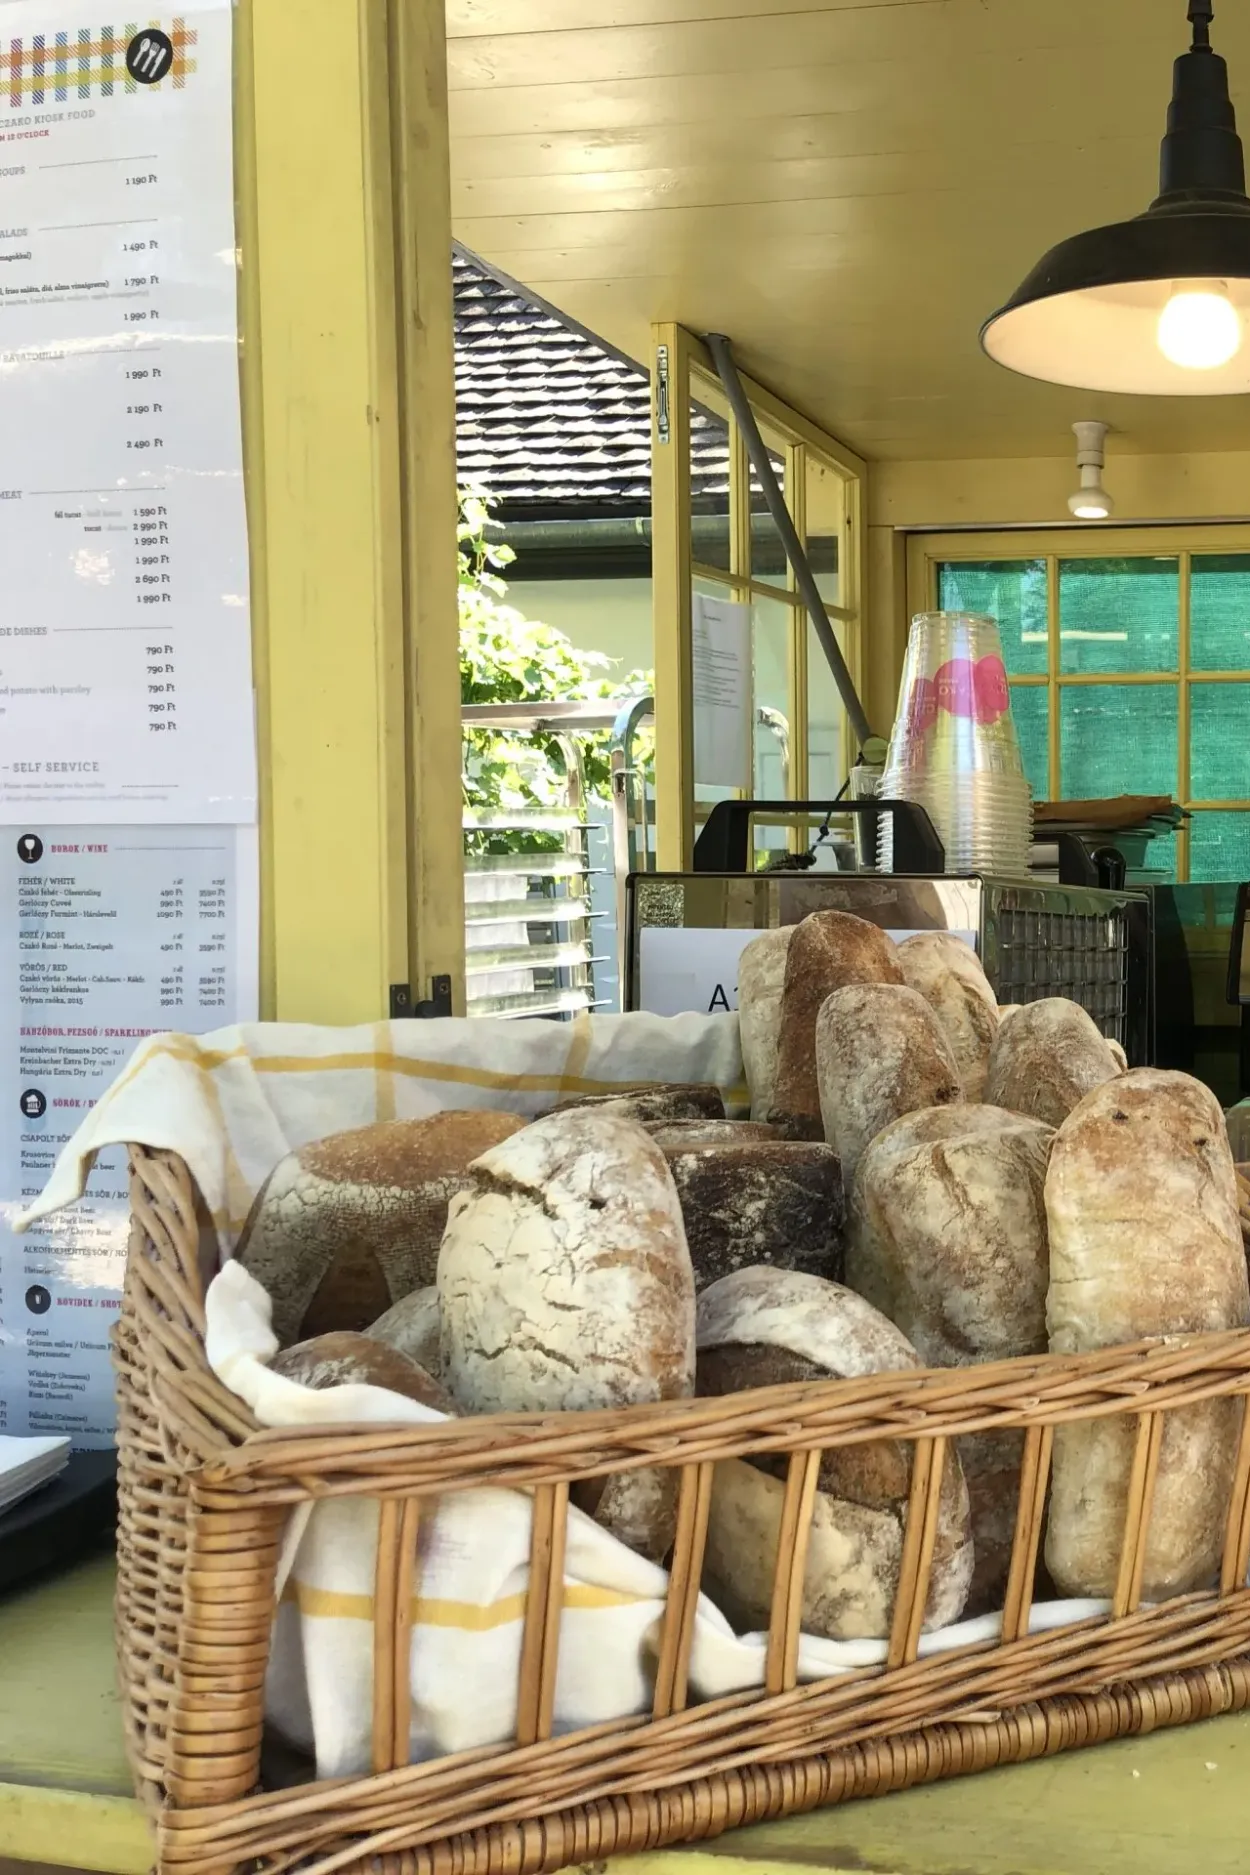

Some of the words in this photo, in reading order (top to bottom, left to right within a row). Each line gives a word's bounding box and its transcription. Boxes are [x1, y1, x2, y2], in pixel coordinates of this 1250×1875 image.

[34, 113, 65, 125] KIOSK
[67, 109, 96, 120] FOOD
[148, 174, 158, 183] Ft
[0, 228, 28, 239] ALADS
[149, 240, 159, 249] Ft
[150, 275, 160, 285] Ft
[150, 310, 160, 319] Ft
[132, 370, 149, 379] 990
[152, 368, 162, 378] Ft
[153, 403, 163, 413] Ft
[154, 438, 164, 448] Ft
[158, 506, 168, 516] Ft
[140, 522, 157, 532] 990
[158, 521, 169, 530] Ft
[141, 536, 158, 546] 990
[159, 535, 169, 545] Ft
[142, 556, 159, 565] 990
[160, 554, 170, 564] Ft
[161, 573, 171, 583] Ft
[143, 594, 160, 604] 990
[162, 593, 172, 602] Ft
[146, 646, 163, 655] 790
[164, 644, 174, 654] Ft
[146, 665, 164, 674] 790
[165, 664, 175, 673] Ft
[147, 684, 165, 694] 790
[166, 683, 176, 692] Ft
[148, 703, 165, 713] 790
[166, 702, 177, 711] Ft
[149, 722, 166, 732] 790
[167, 721, 177, 731] Ft
[12, 761, 42, 773] SELF
[45, 761, 101, 773] SERVICE
[87, 844, 108, 853] WINE
[49, 877, 76, 885] WHITE
[52, 963, 69, 972] RED
[91, 1046, 109, 1055] DOC
[83, 1057, 97, 1067] Dry
[73, 1068, 87, 1078] Dry
